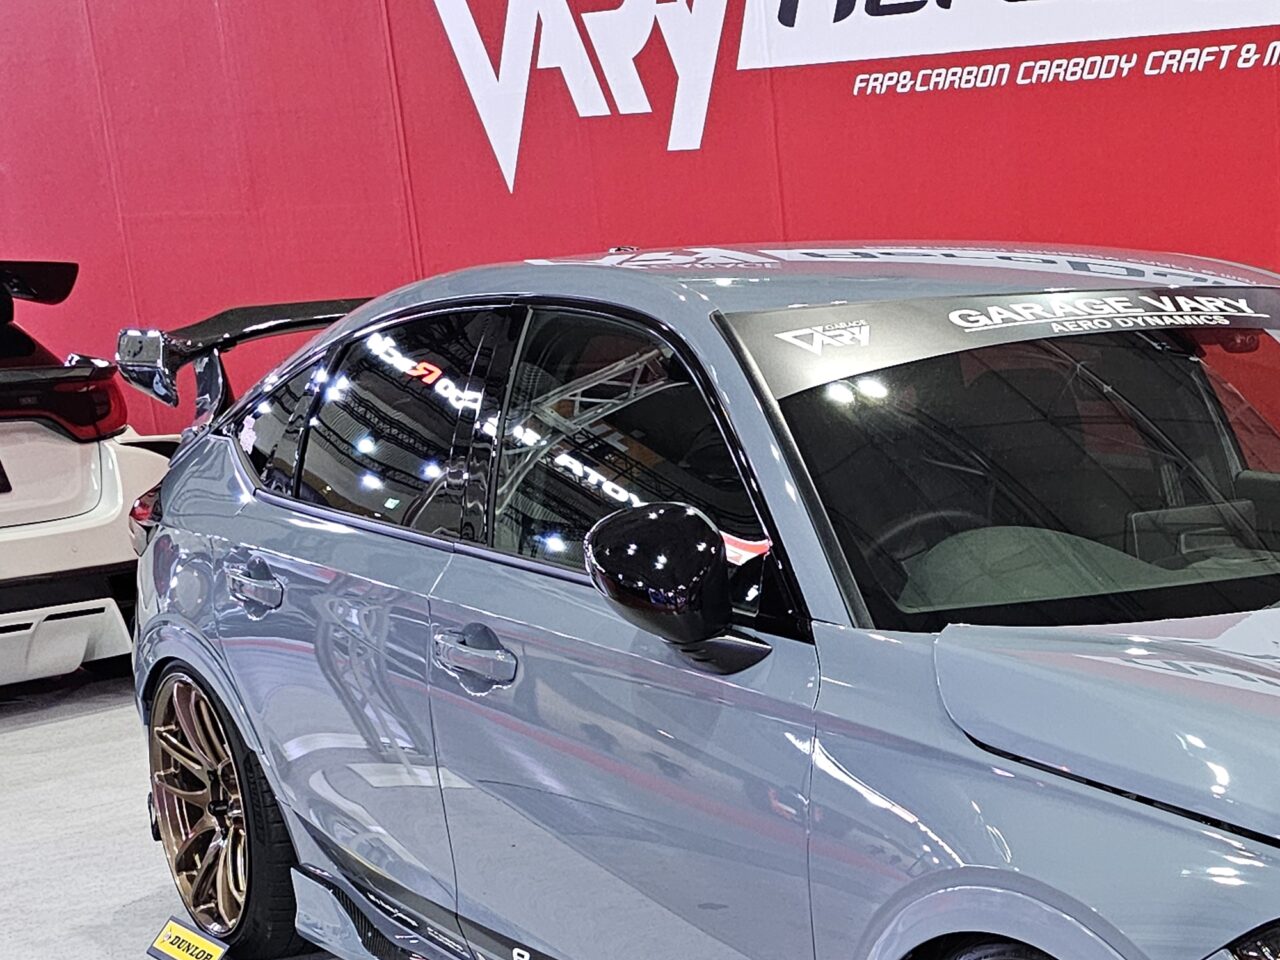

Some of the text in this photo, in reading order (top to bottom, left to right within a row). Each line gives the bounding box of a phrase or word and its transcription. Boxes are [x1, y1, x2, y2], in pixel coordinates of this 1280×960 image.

[852, 62, 1011, 96] FRP&CARBON
[1015, 52, 1138, 85] CARBODY
[1144, 44, 1237, 76] CRAFT
[948, 294, 1257, 329] GARAGE VARY
[1050, 315, 1231, 334] AERO DYNAMICS
